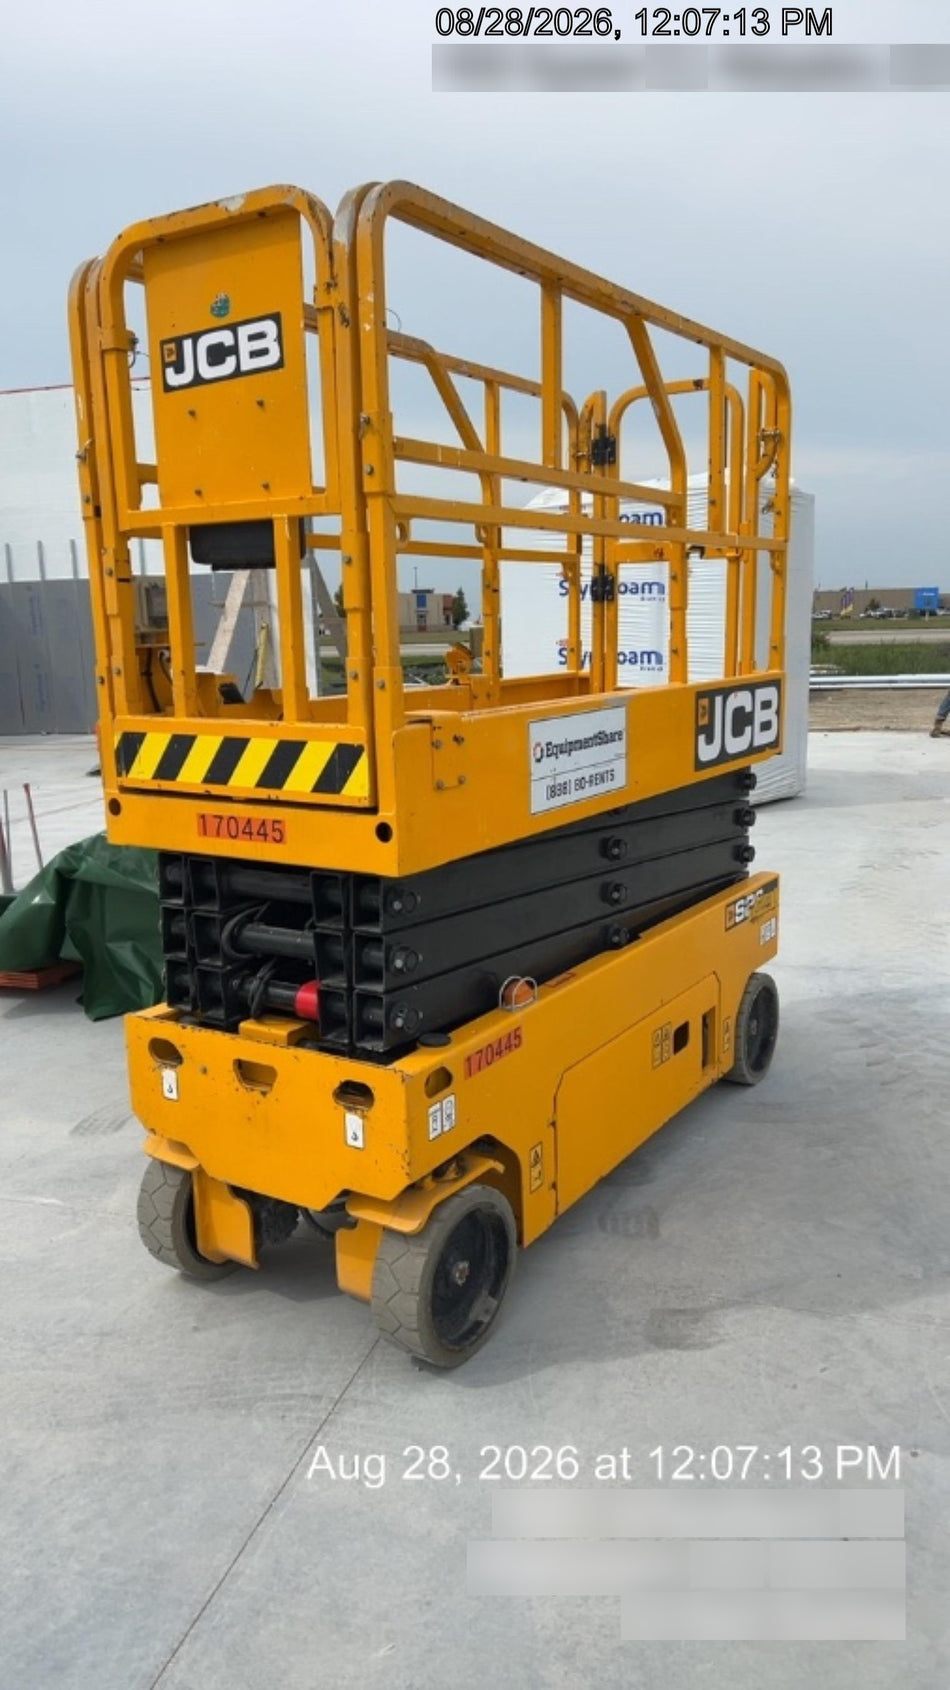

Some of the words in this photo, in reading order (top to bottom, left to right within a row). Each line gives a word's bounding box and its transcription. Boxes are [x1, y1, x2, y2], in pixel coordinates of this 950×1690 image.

[164, 319, 281, 387] JCB
[545, 730, 623, 759] EquipmentShare
[697, 686, 779, 762] JCB
[200, 814, 284, 844] 170445
[465, 1025, 522, 1078] 170445
